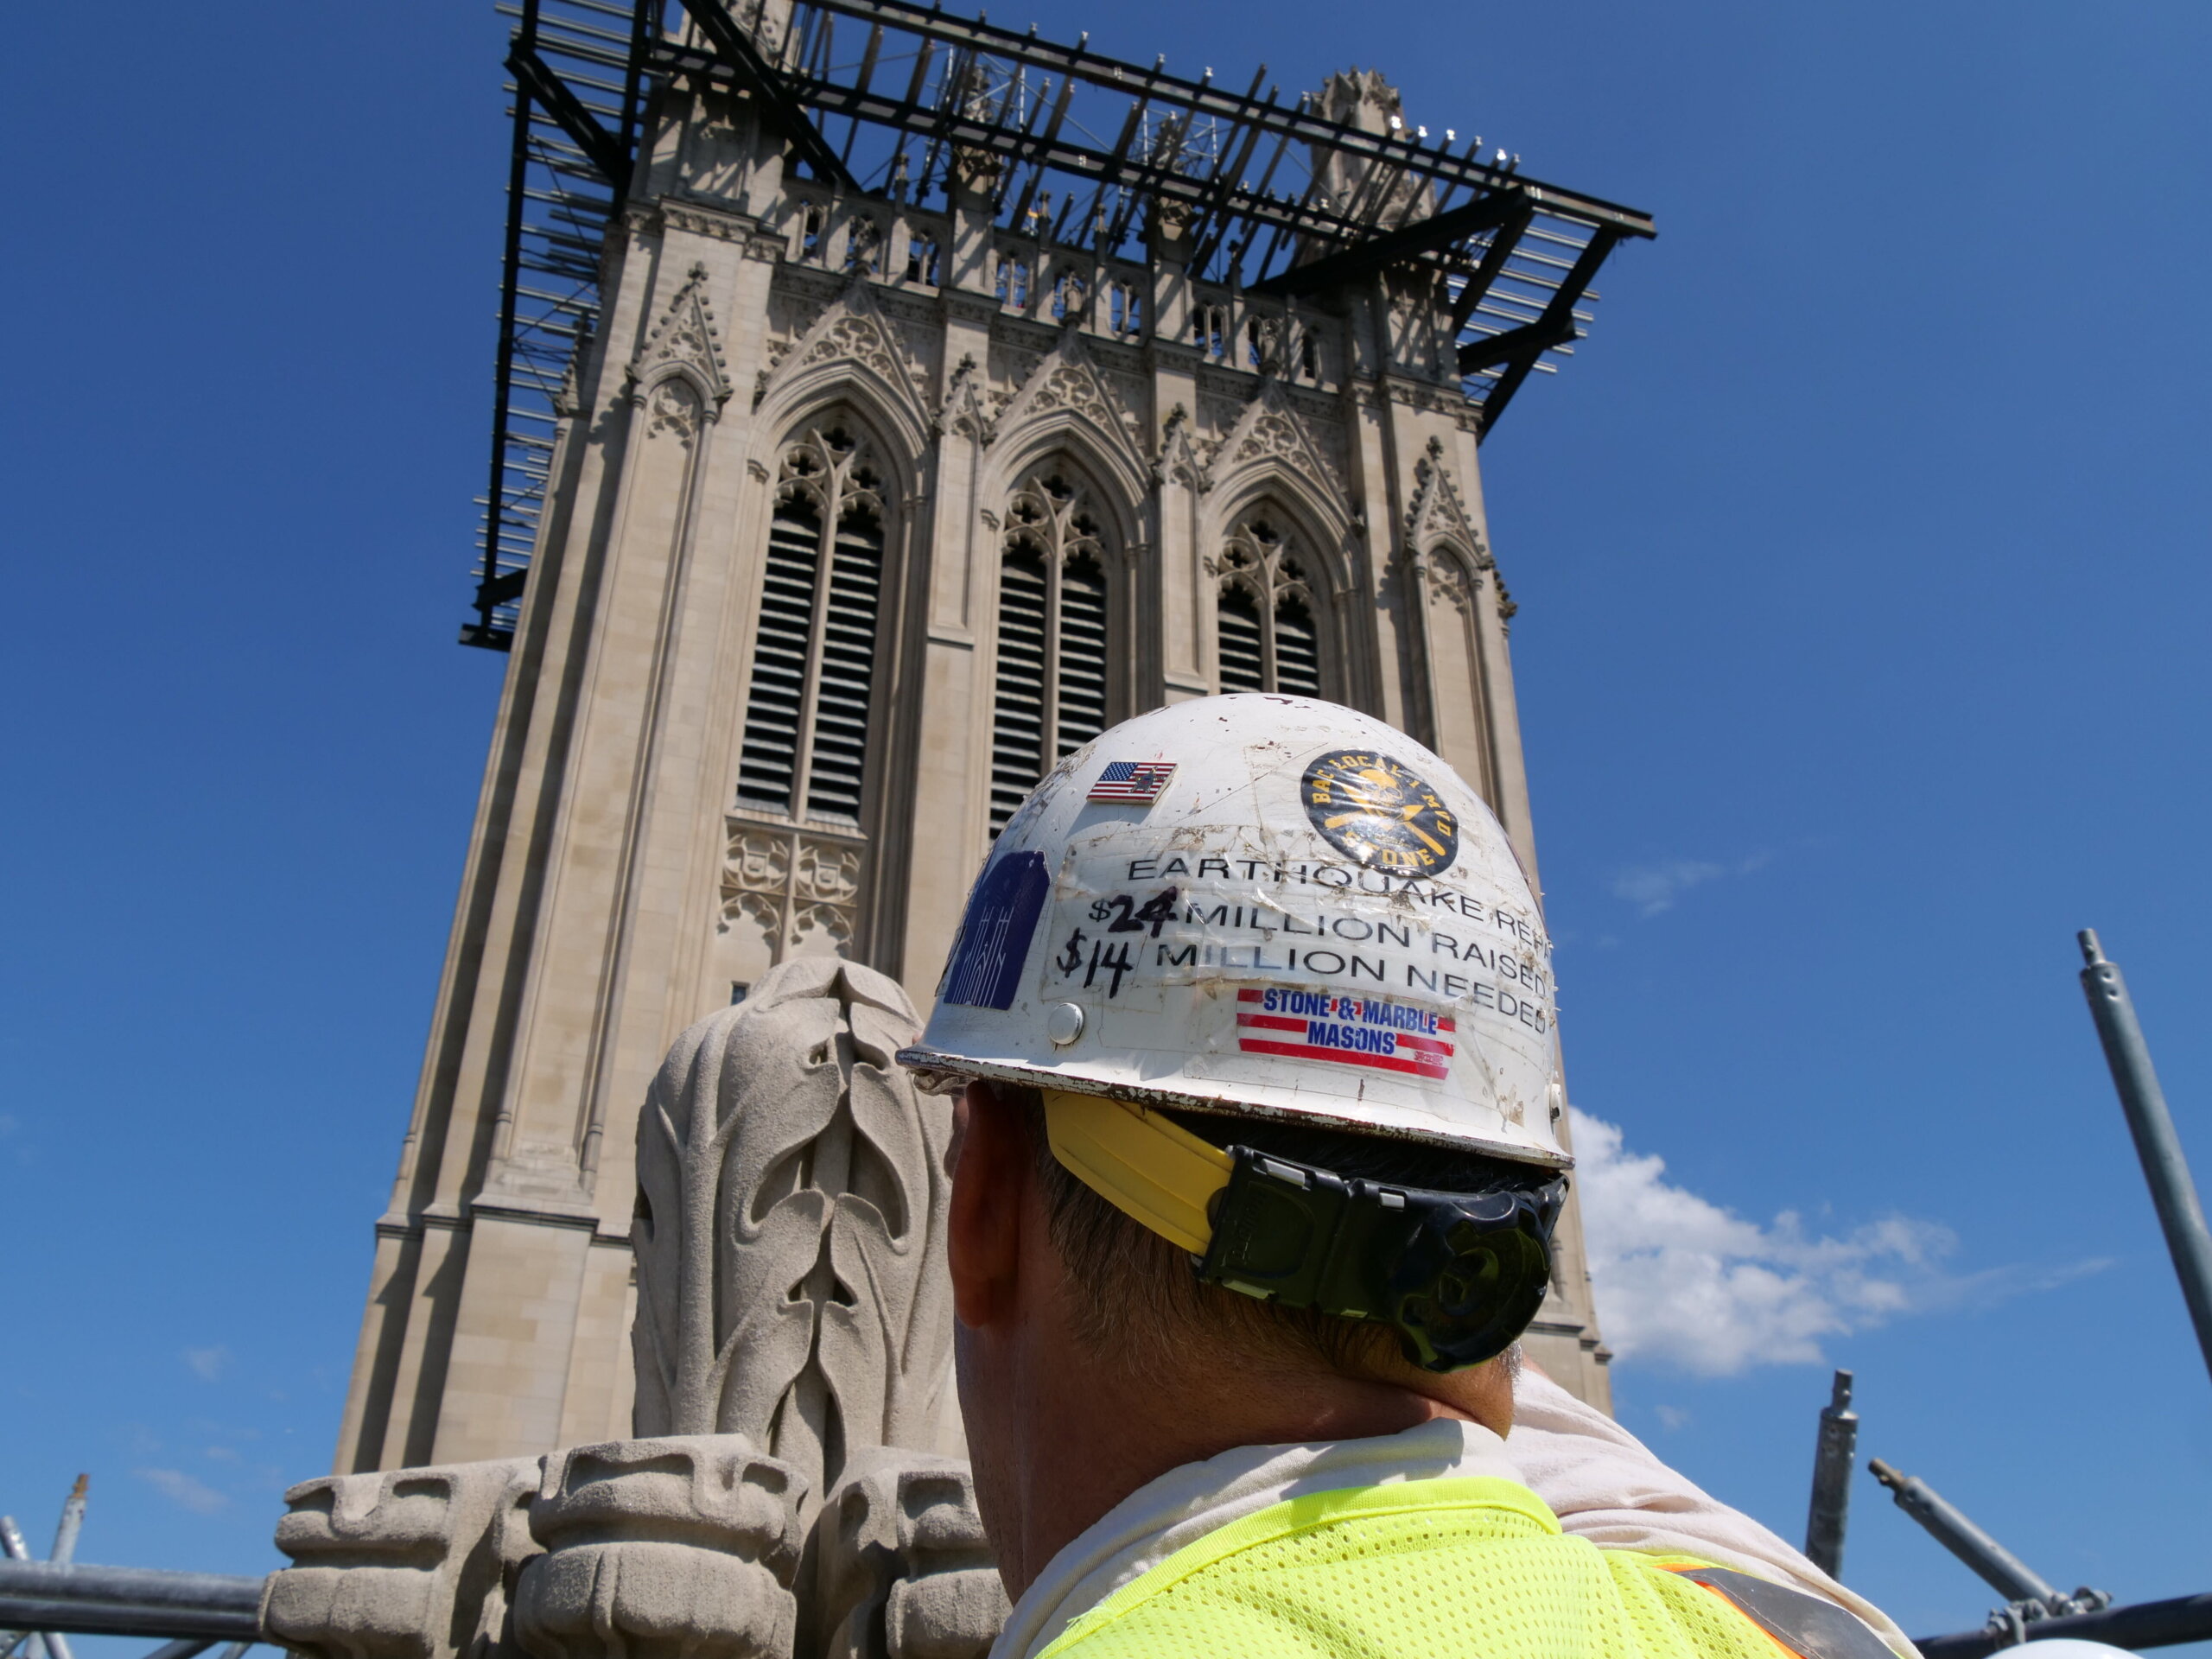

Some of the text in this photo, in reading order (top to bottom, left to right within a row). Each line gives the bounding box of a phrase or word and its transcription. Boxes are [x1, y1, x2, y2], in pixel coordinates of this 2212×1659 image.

[1312, 770, 1335, 804] BAC
[1328, 755, 1403, 779] LOCAL
[1128, 858, 1484, 922] EARTHQUAKE
[1185, 902, 1410, 948] MILLION
[1432, 932, 1547, 1000] RAISED
[1056, 927, 1546, 1034] $14 MILLION NEEDED
[1263, 988, 1438, 1035] STONE & MARBLE
[1307, 1021, 1395, 1055] MASONS
